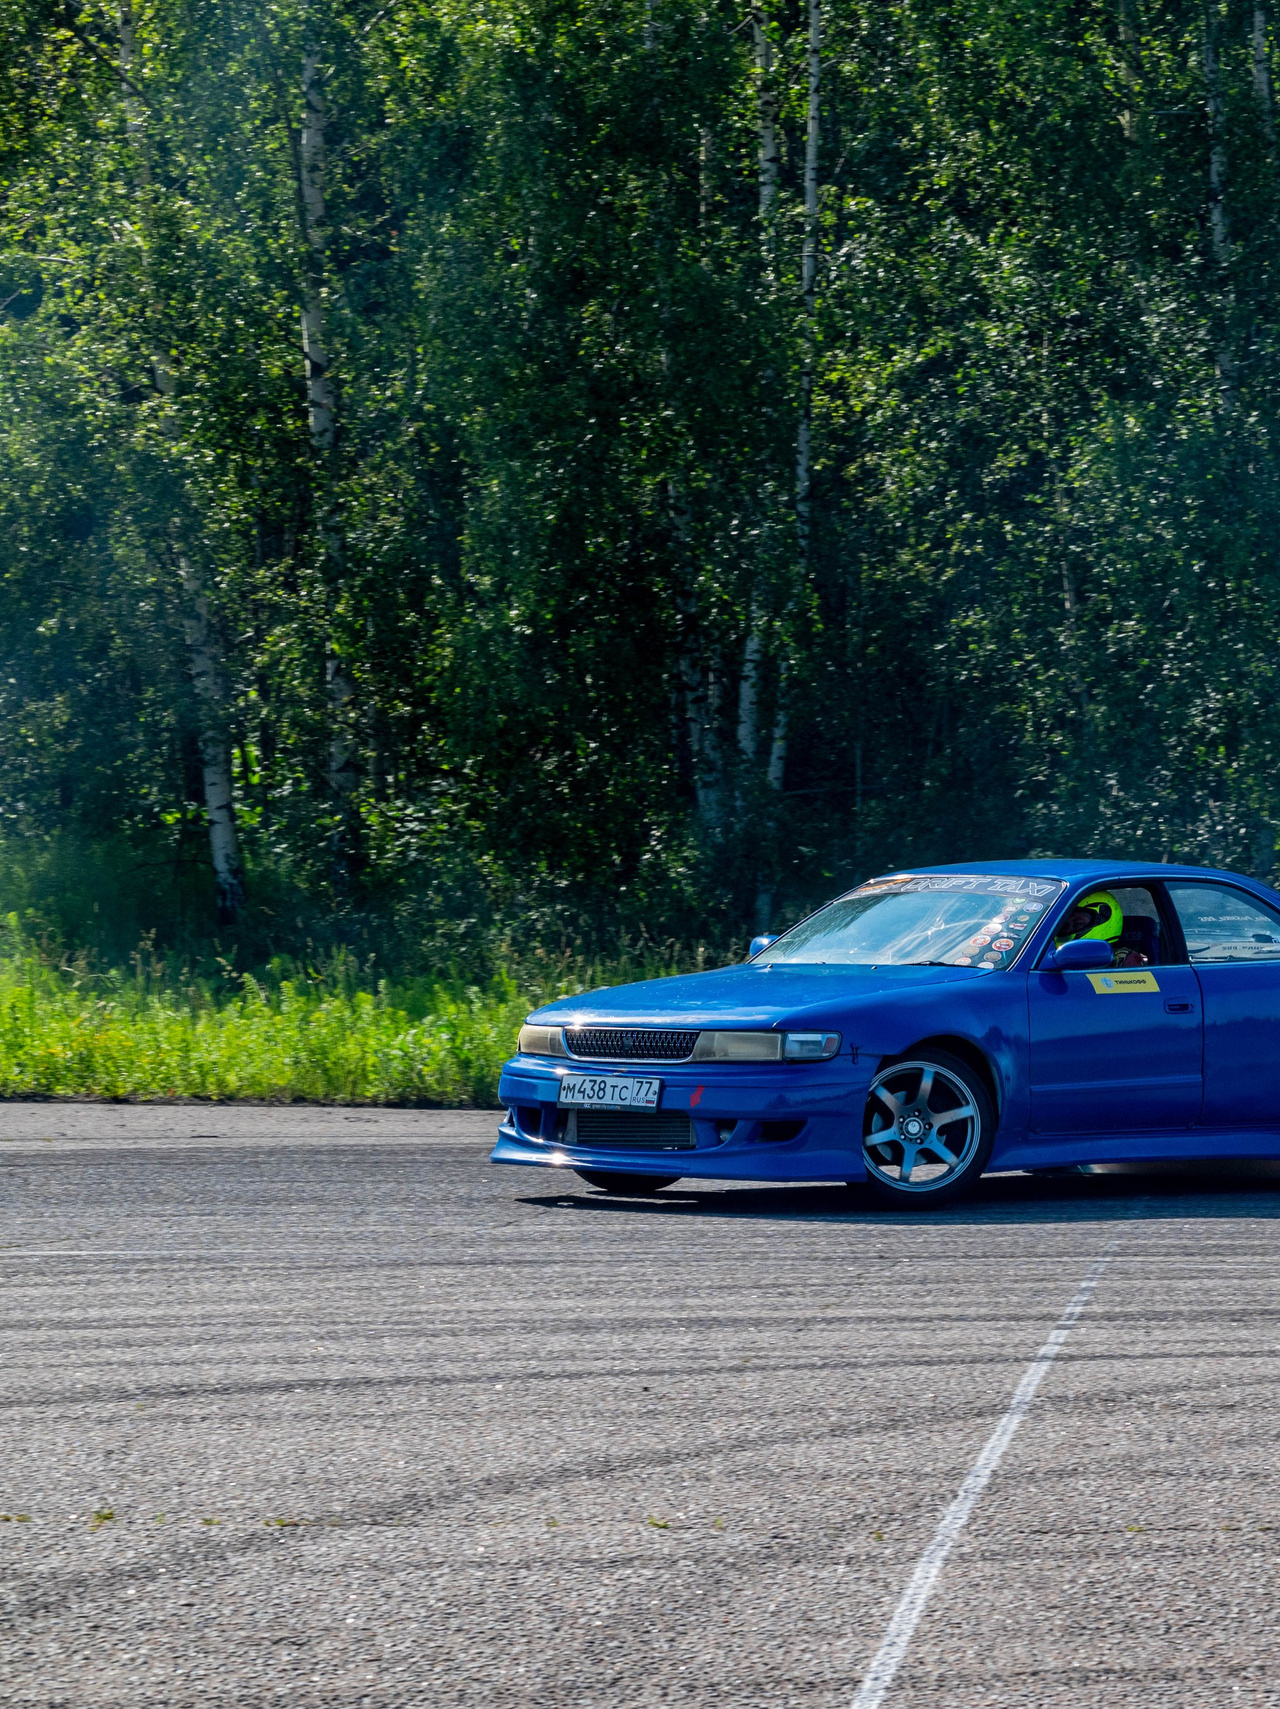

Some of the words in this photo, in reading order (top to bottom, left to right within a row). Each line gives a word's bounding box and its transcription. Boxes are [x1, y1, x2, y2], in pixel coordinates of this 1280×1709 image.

[901, 877, 992, 892] DRIFT
[987, 878, 1056, 898] TAXI
[635, 1081, 653, 1097] 77
